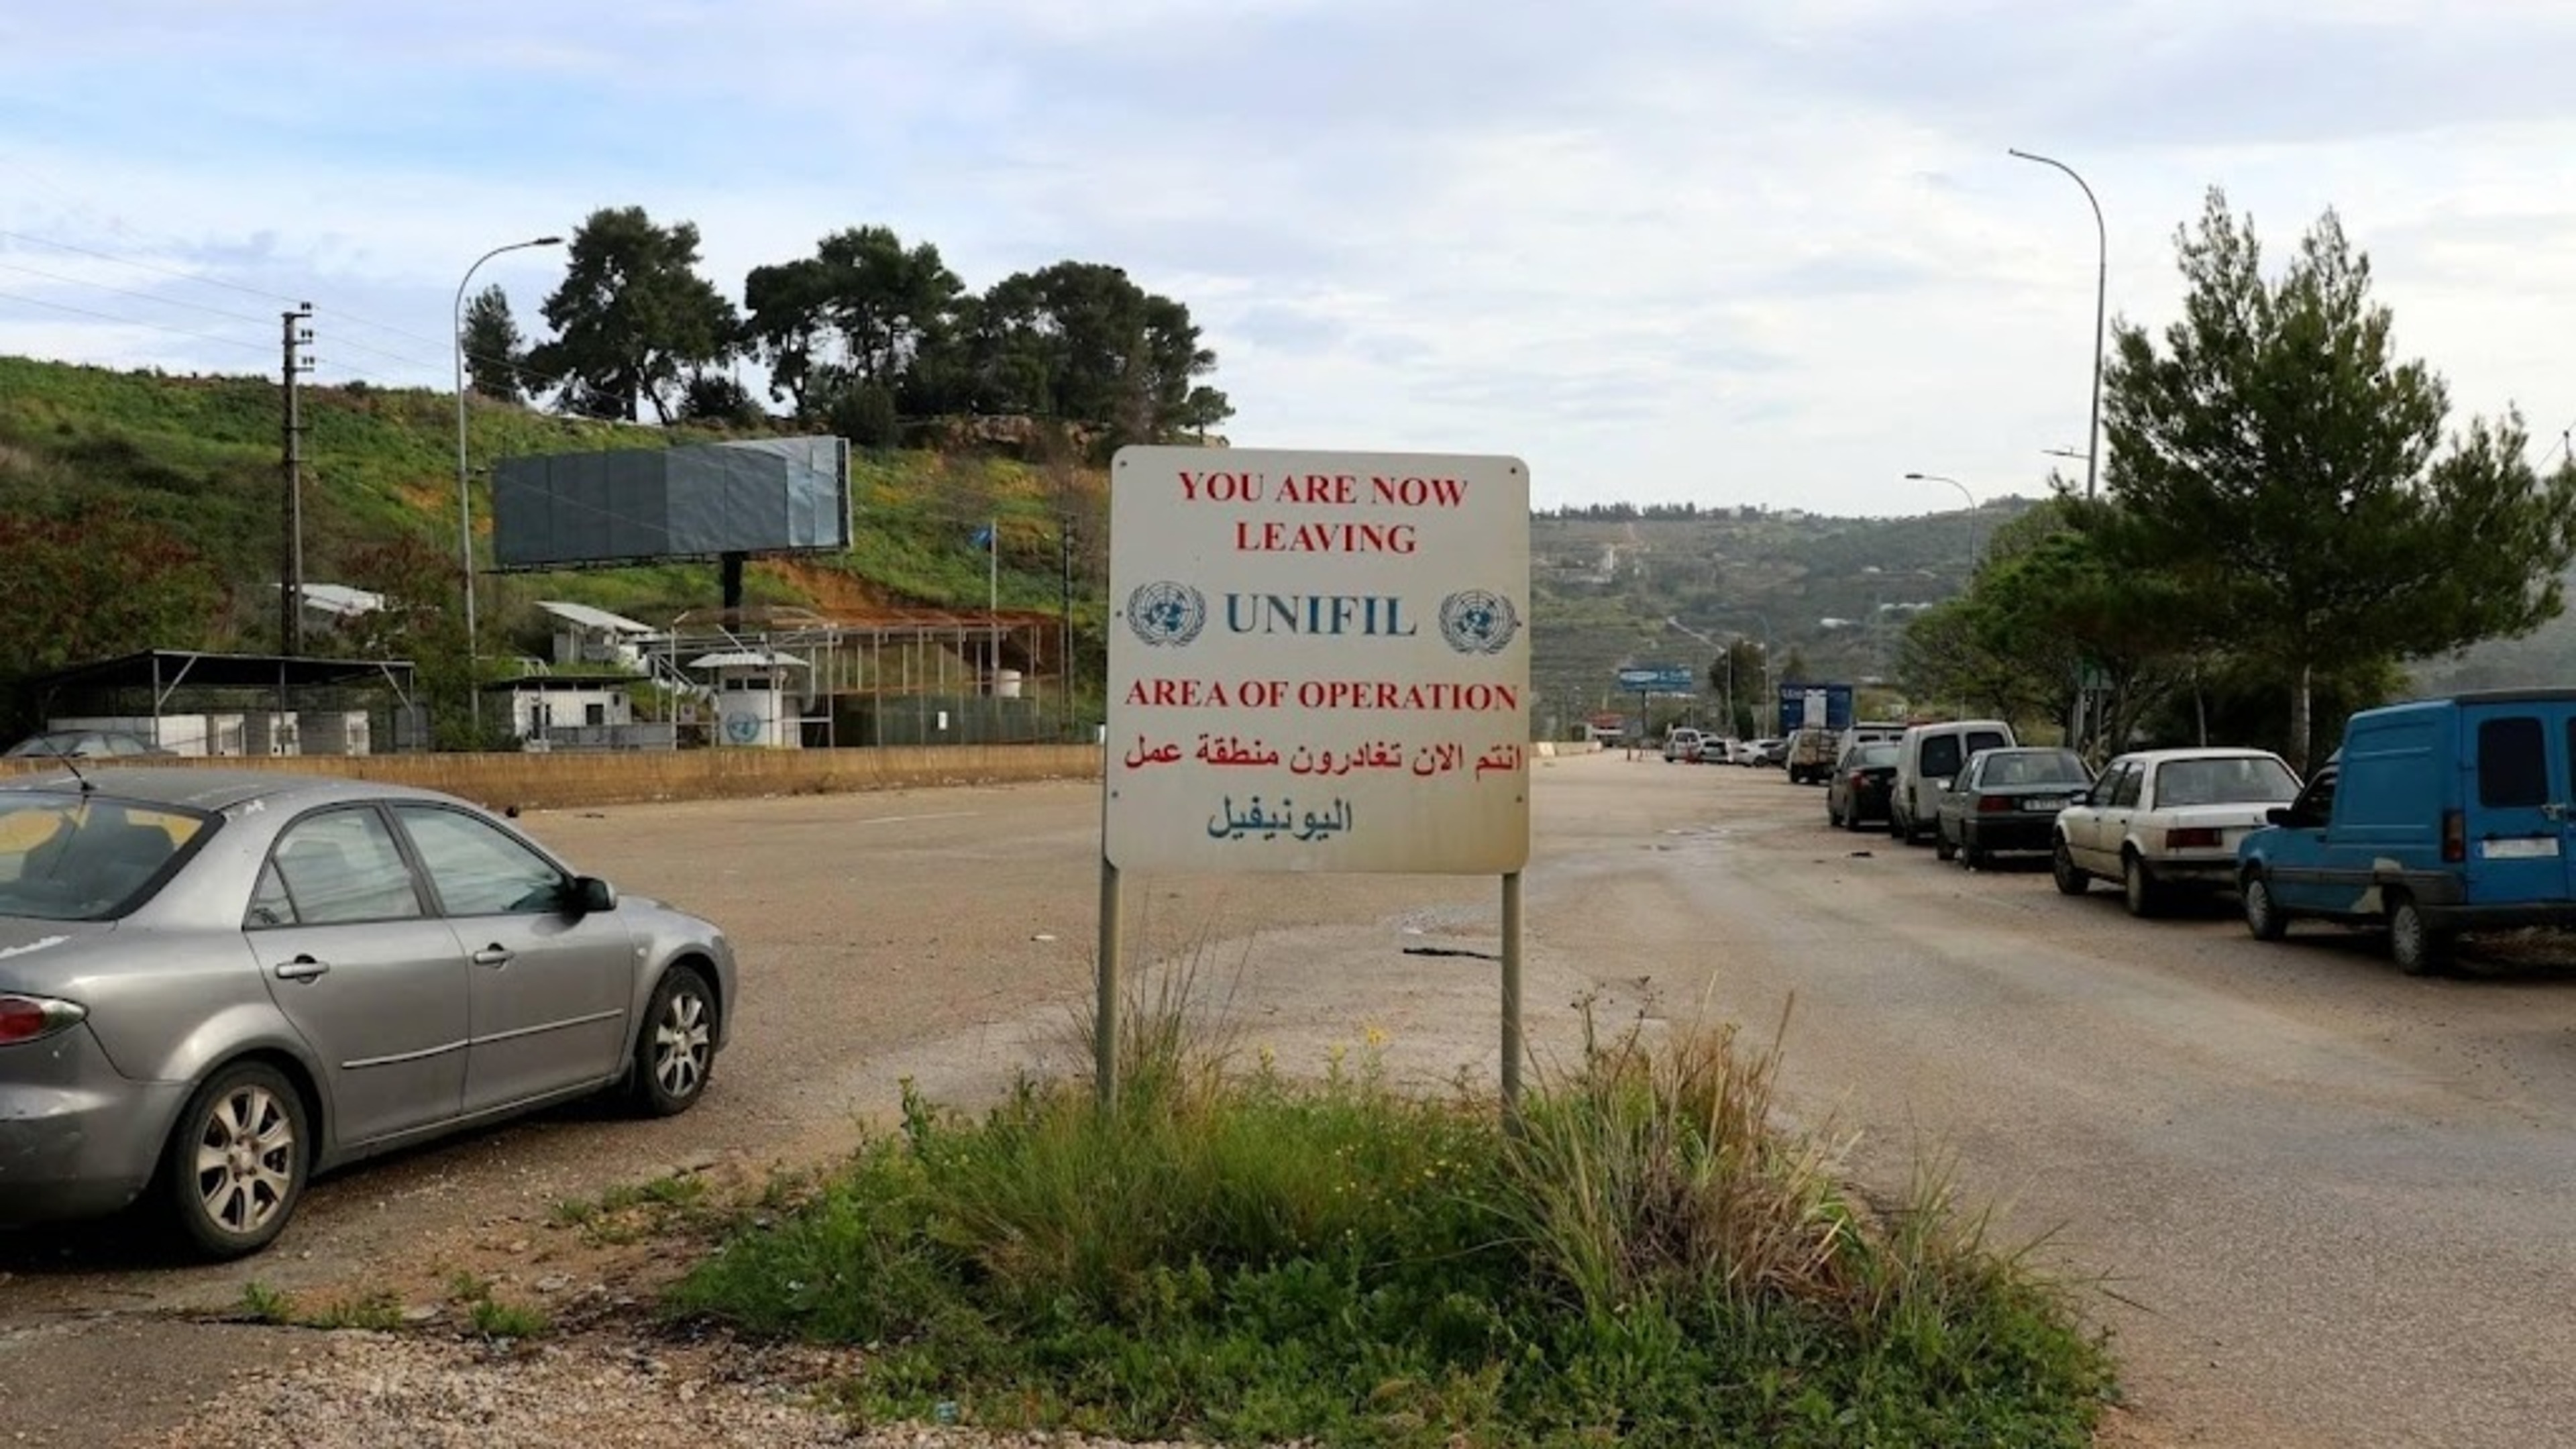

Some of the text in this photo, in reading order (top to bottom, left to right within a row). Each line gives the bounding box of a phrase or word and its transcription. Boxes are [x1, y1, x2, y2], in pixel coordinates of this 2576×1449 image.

[1179, 472, 1468, 507] YOU ARE NOW
[1236, 521, 1416, 554] LEAVING
[1224, 593, 1417, 637] UNIFIL
[1124, 679, 1518, 711] AREA OF OPERATION
[1124, 733, 1522, 782] انتم الان تغادرون منطقة عمل
[1207, 795, 1353, 842] اليونيفيل
